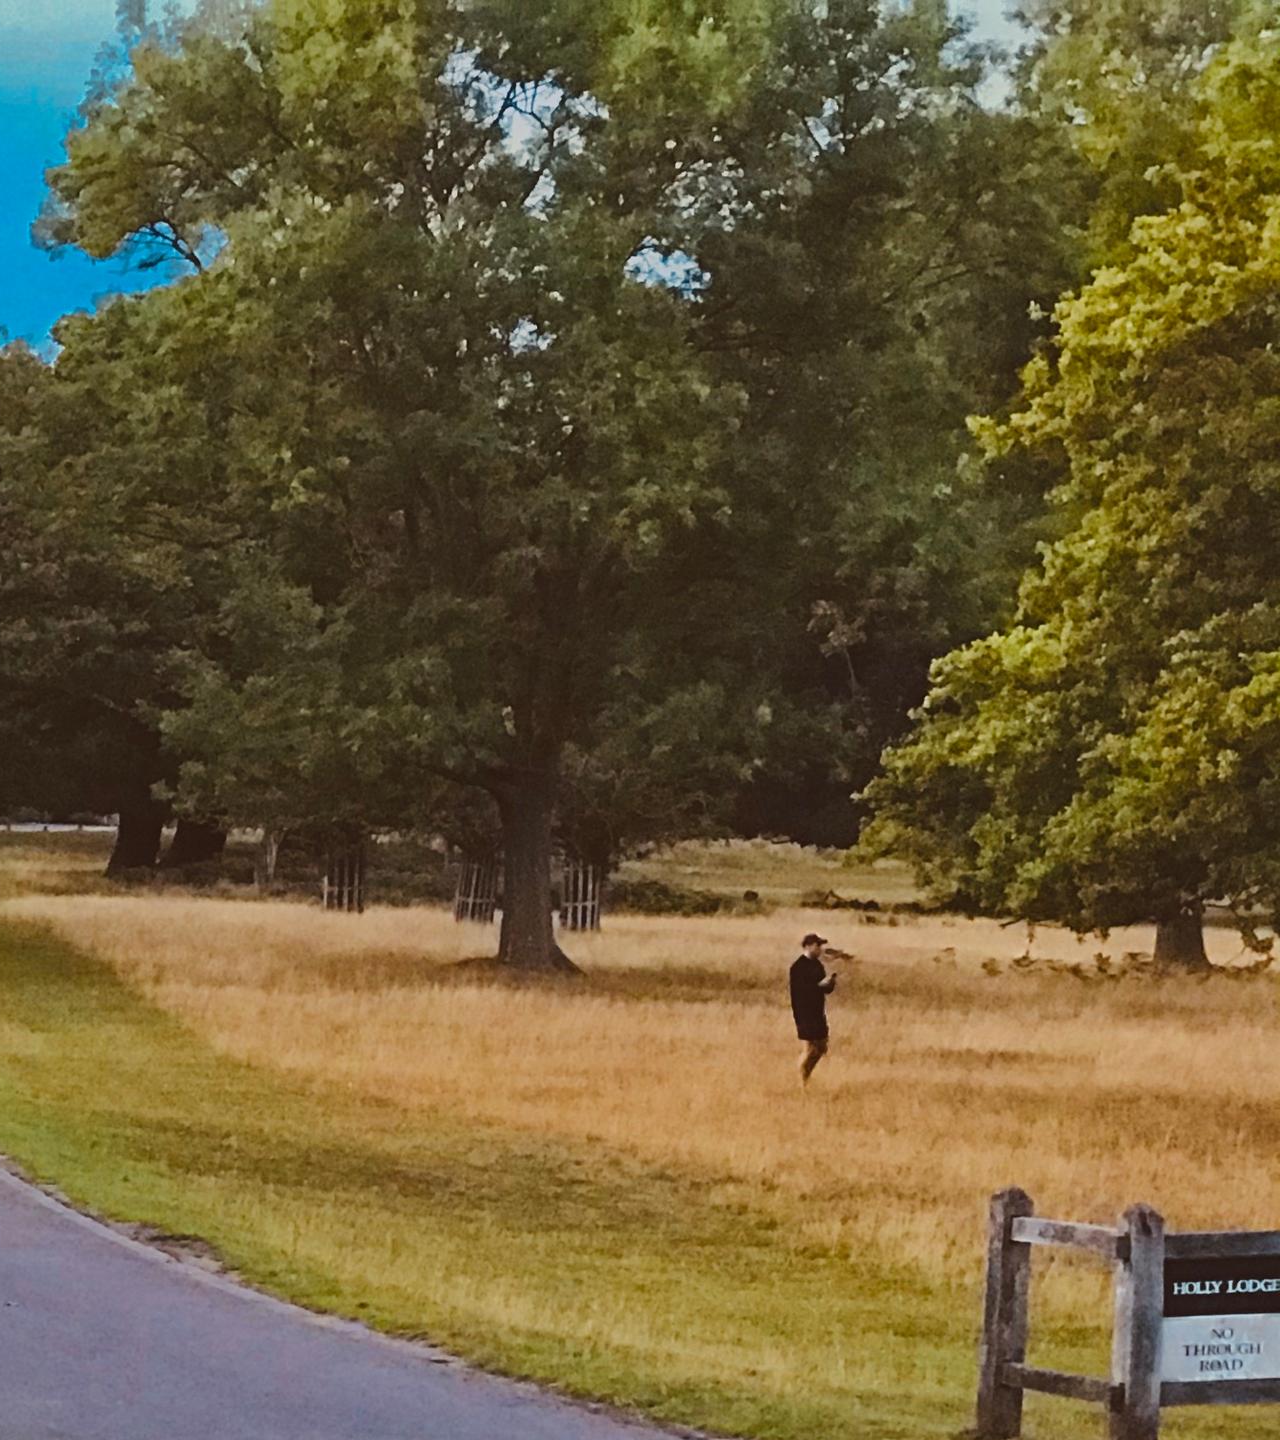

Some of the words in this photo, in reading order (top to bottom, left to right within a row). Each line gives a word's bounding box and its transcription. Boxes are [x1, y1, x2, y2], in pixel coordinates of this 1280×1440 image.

[1173, 1280, 1222, 1295] HOLLY
[1226, 1278, 1280, 1293] LODGE
[1212, 1328, 1234, 1339] NO
[1183, 1343, 1261, 1356] THROUGH
[1200, 1359, 1244, 1372] ROAD
